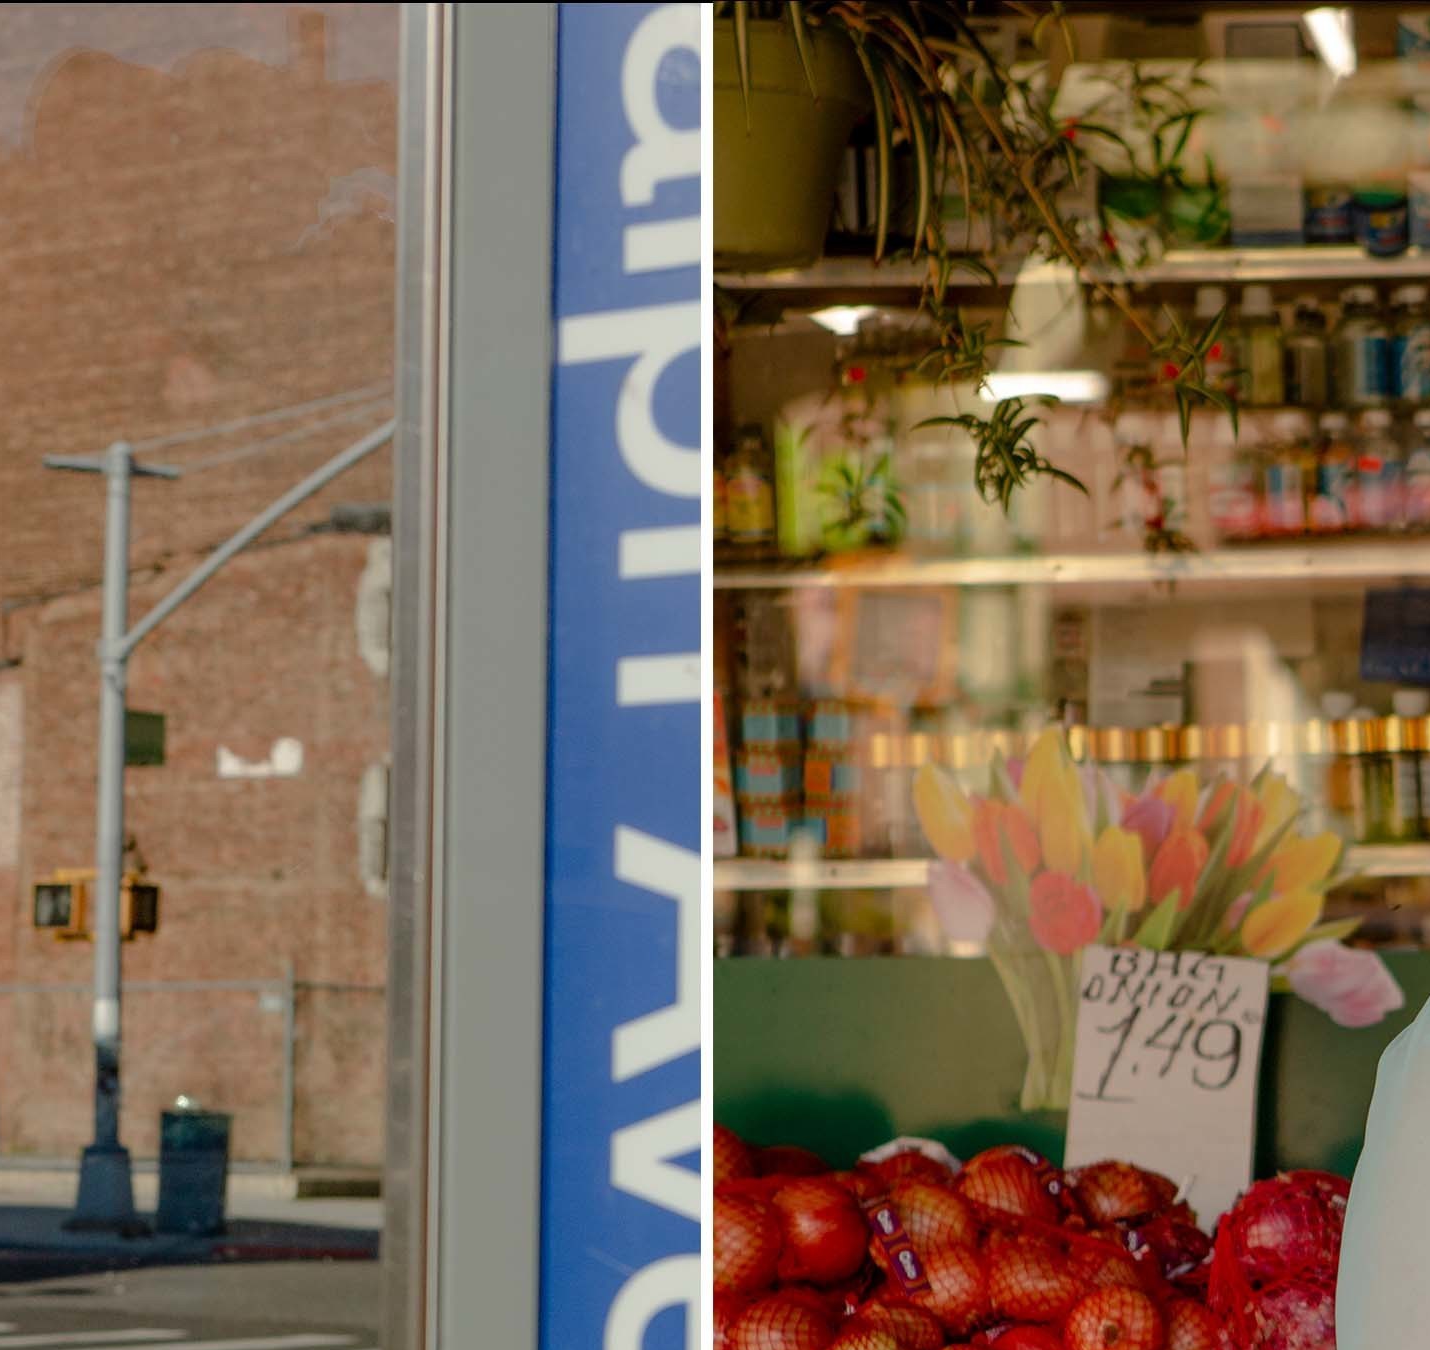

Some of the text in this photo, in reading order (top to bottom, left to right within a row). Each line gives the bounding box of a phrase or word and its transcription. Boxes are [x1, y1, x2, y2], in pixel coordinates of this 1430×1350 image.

[1110, 951, 1225, 982] BAG
[1082, 974, 1240, 1015] ONION
[1077, 1005, 1242, 1101] 1.49
